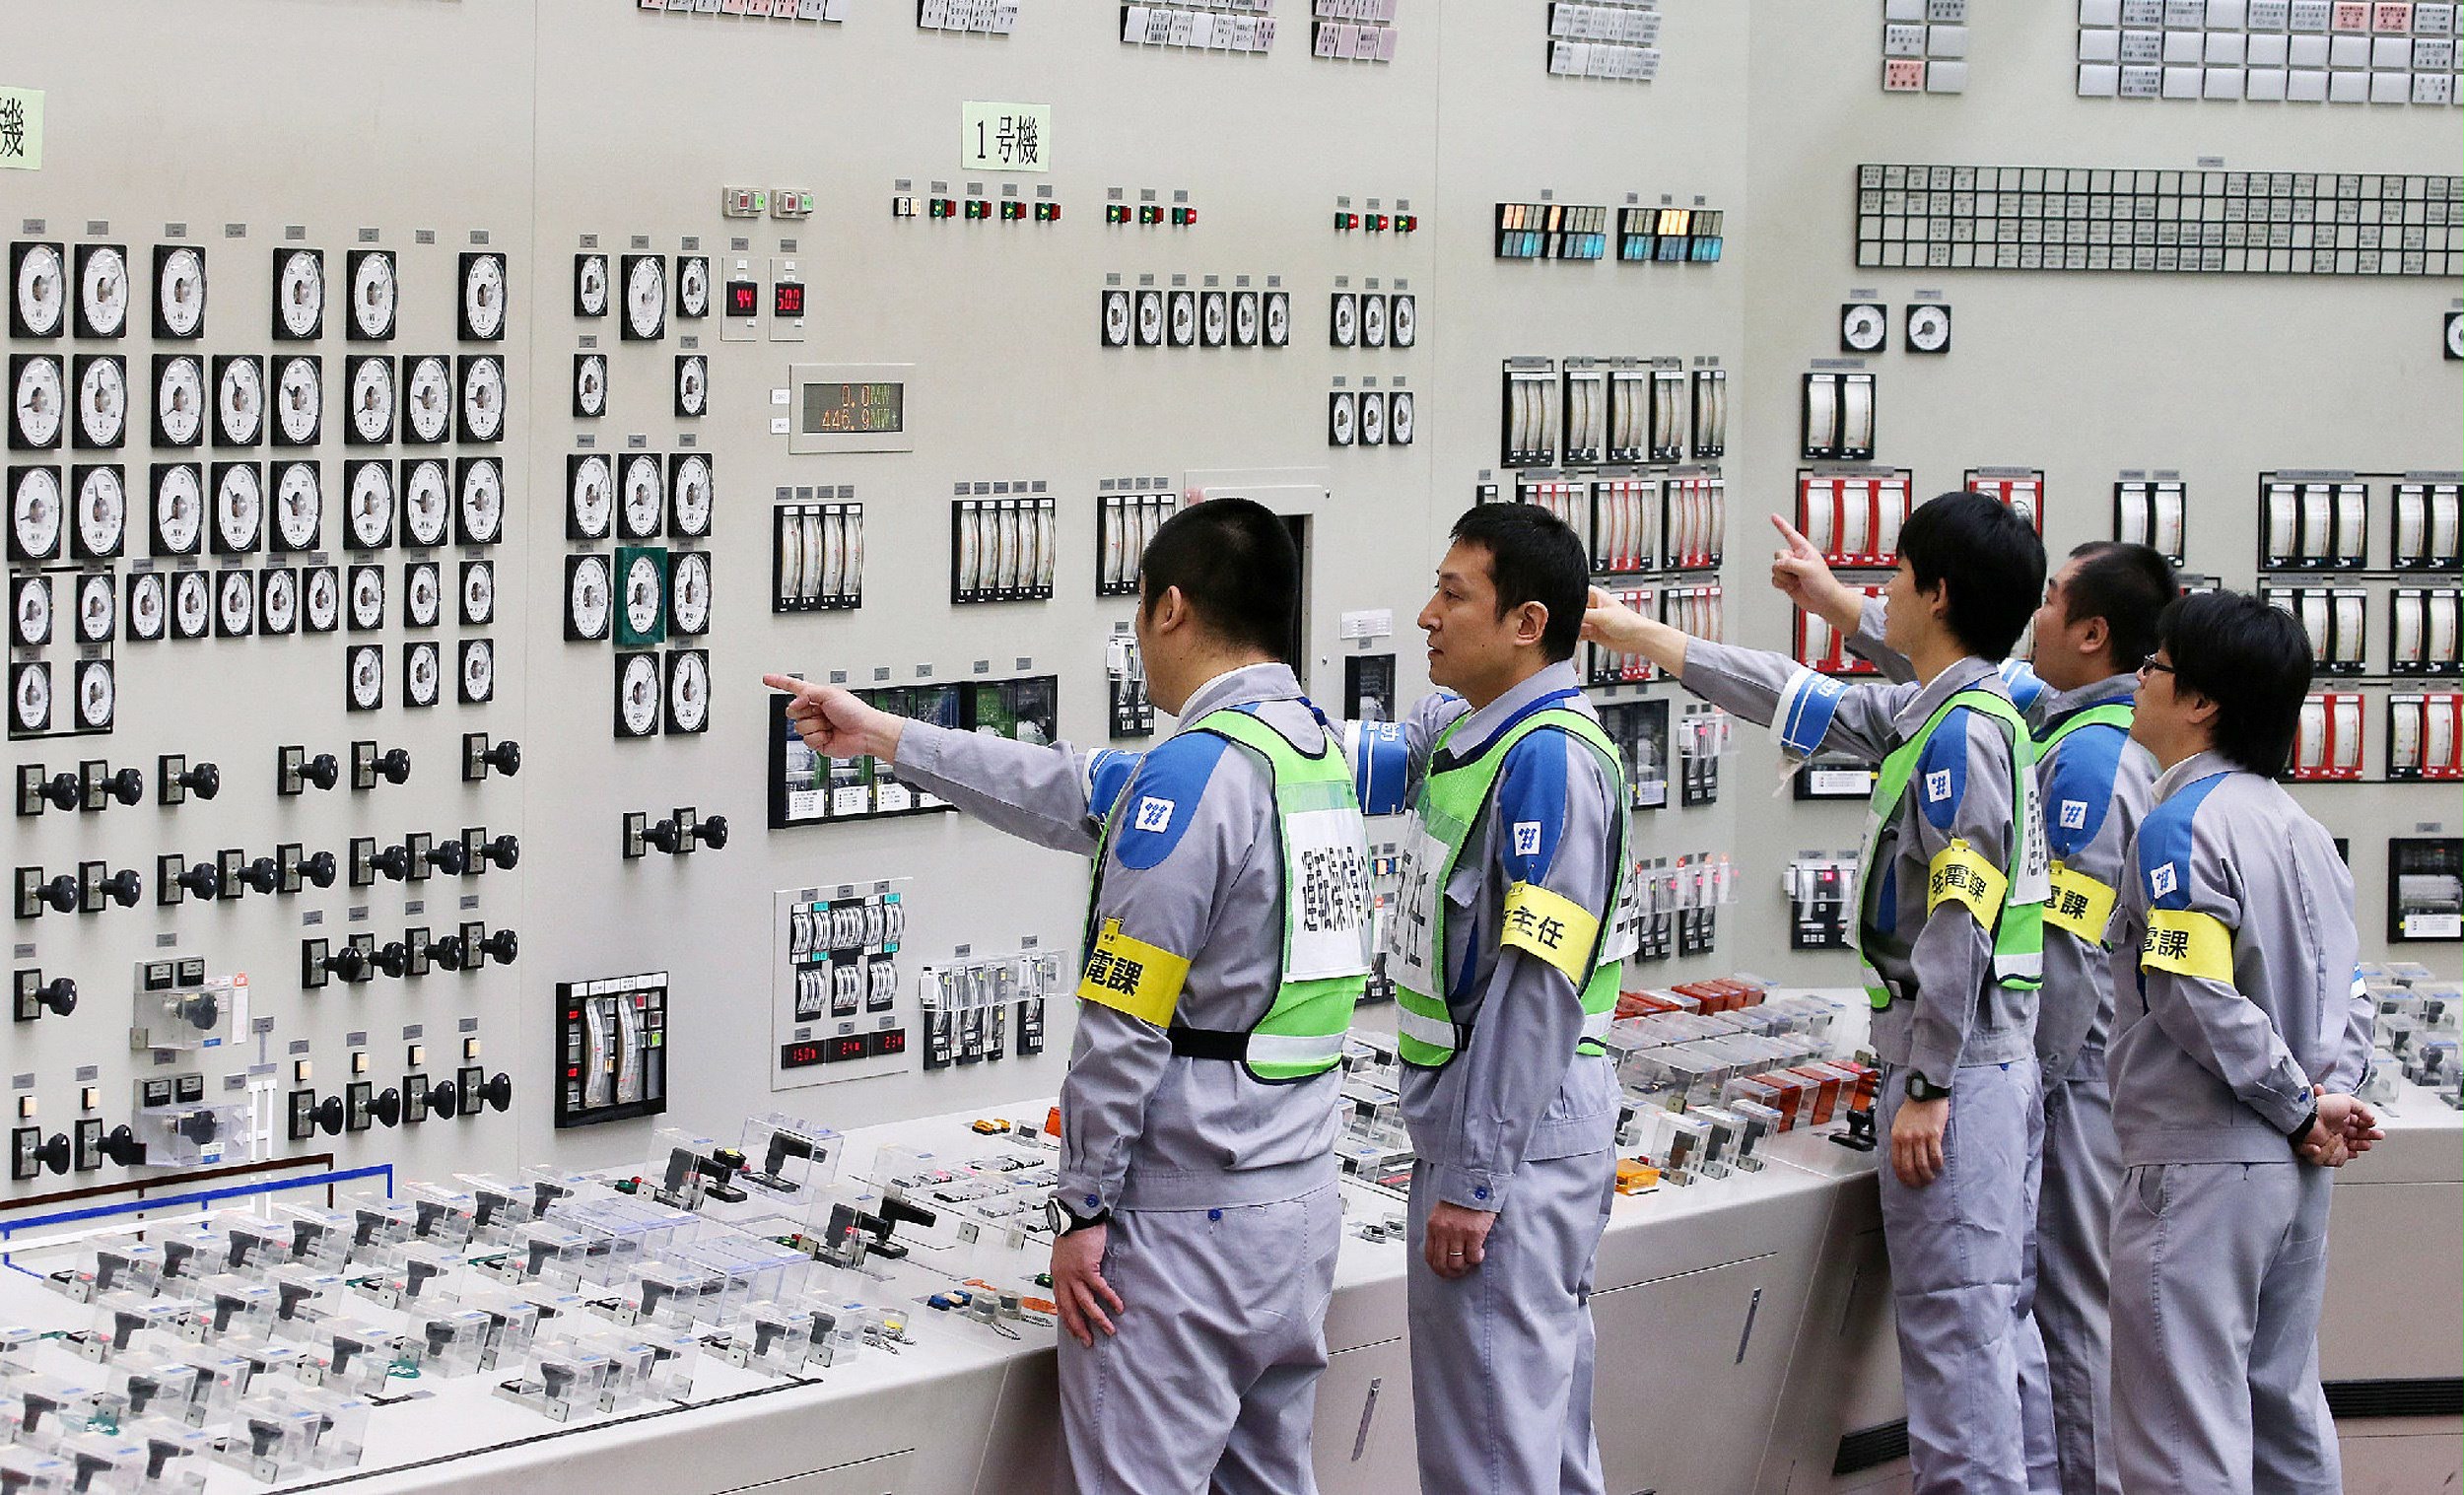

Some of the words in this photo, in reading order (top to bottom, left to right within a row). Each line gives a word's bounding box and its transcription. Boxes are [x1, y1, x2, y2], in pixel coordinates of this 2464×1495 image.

[976, 114, 1038, 165] 1号機
[735, 288, 753, 309] 44
[778, 288, 800, 310] 500
[1503, 905, 1565, 950] 主任
[1086, 948, 1143, 996] 電課
